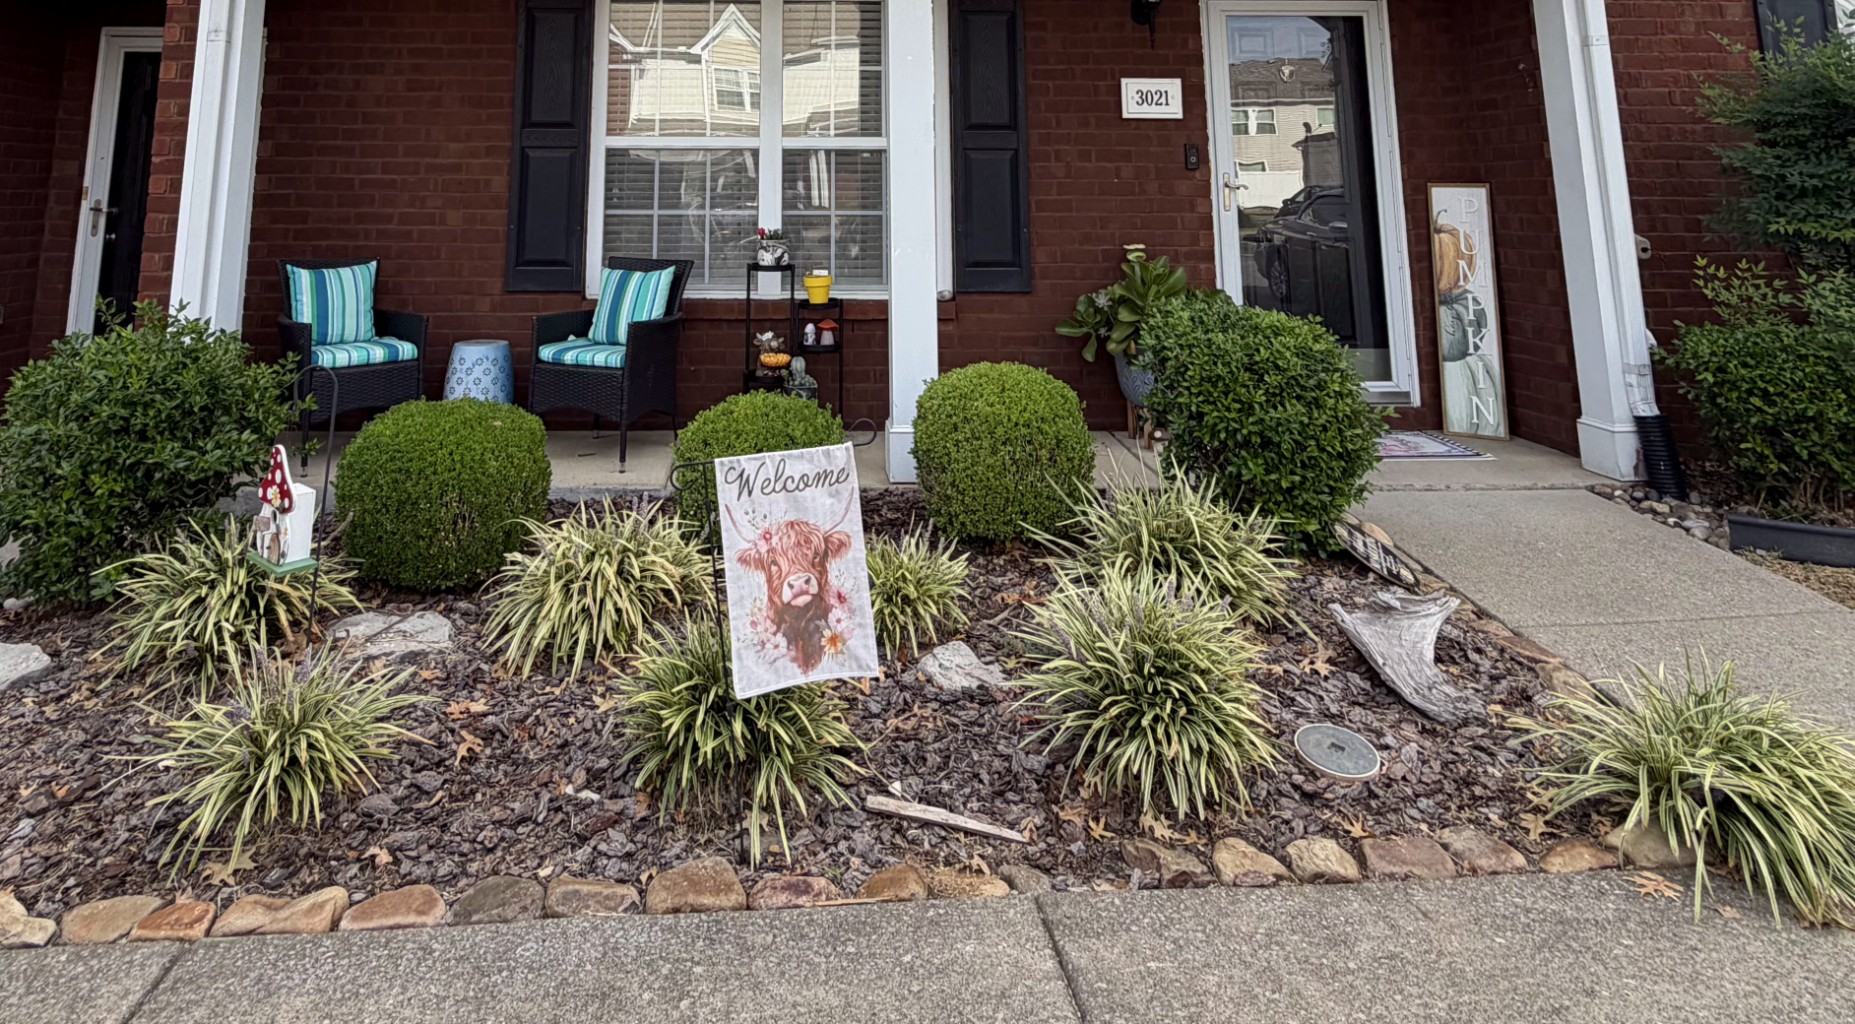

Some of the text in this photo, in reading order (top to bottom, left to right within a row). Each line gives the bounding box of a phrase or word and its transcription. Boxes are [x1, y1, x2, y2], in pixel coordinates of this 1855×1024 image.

[1135, 89, 1170, 106] 3021
[1456, 197, 1495, 425] PUMPKIN
[724, 458, 850, 501] Welcome
